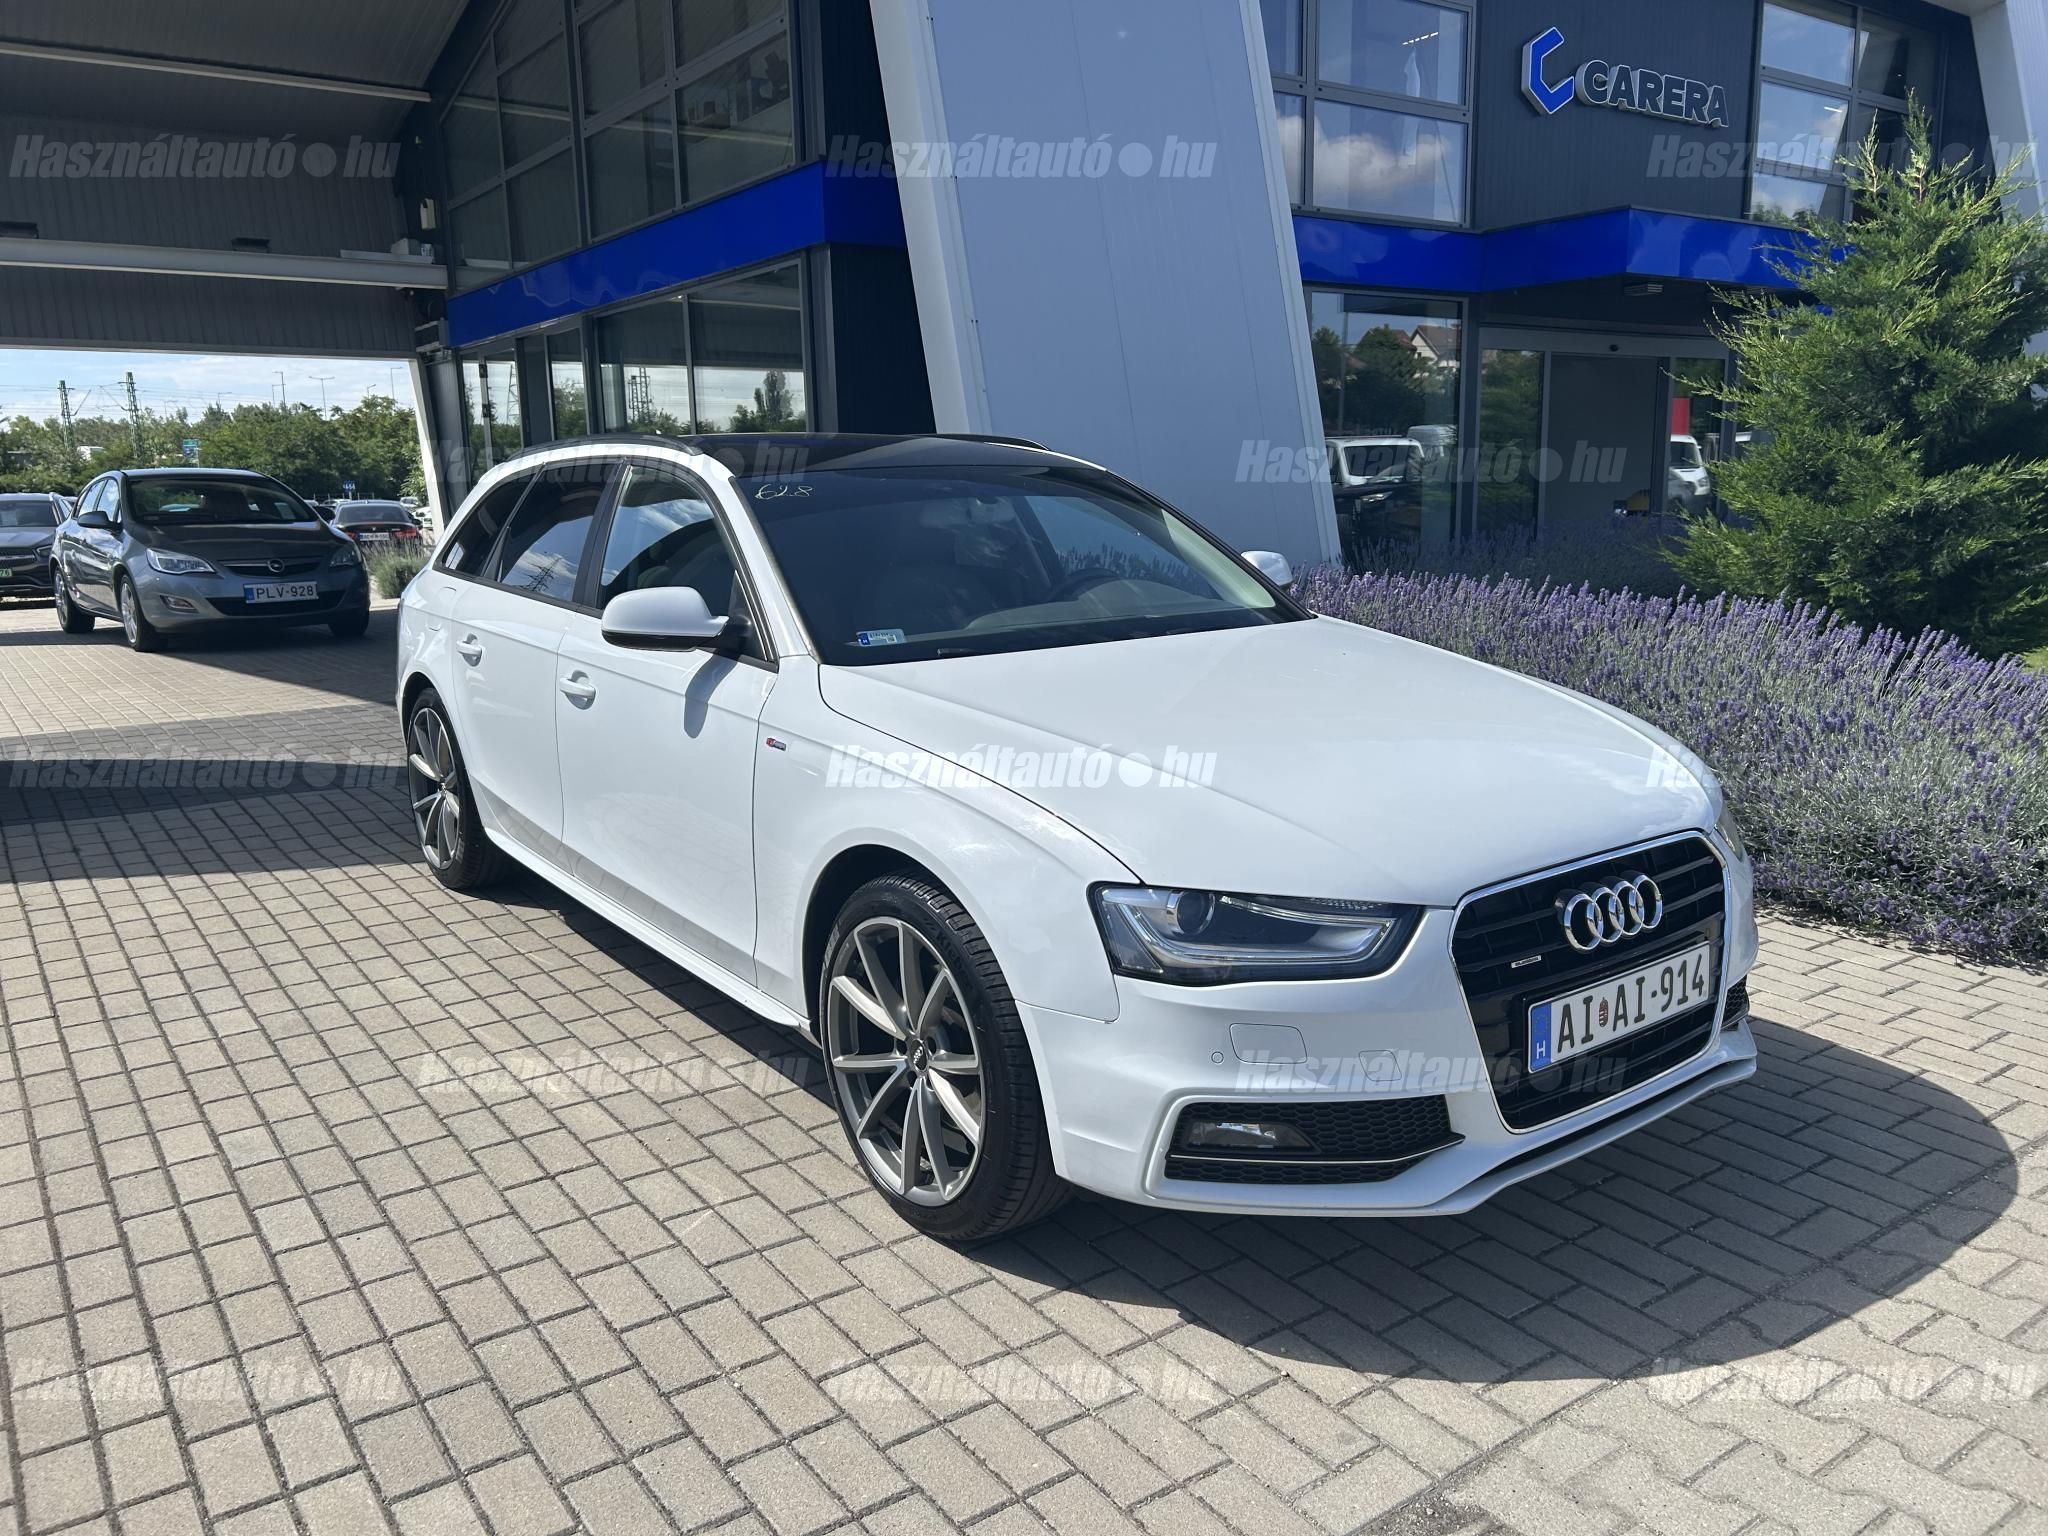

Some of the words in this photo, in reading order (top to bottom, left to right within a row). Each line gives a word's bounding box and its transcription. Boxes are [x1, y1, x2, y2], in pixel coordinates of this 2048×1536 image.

[1576, 59, 1729, 128] CARERA
[256, 585, 314, 600] PLV-928
[1536, 1040, 1546, 1060] H
[1557, 994, 1594, 1054] AI
